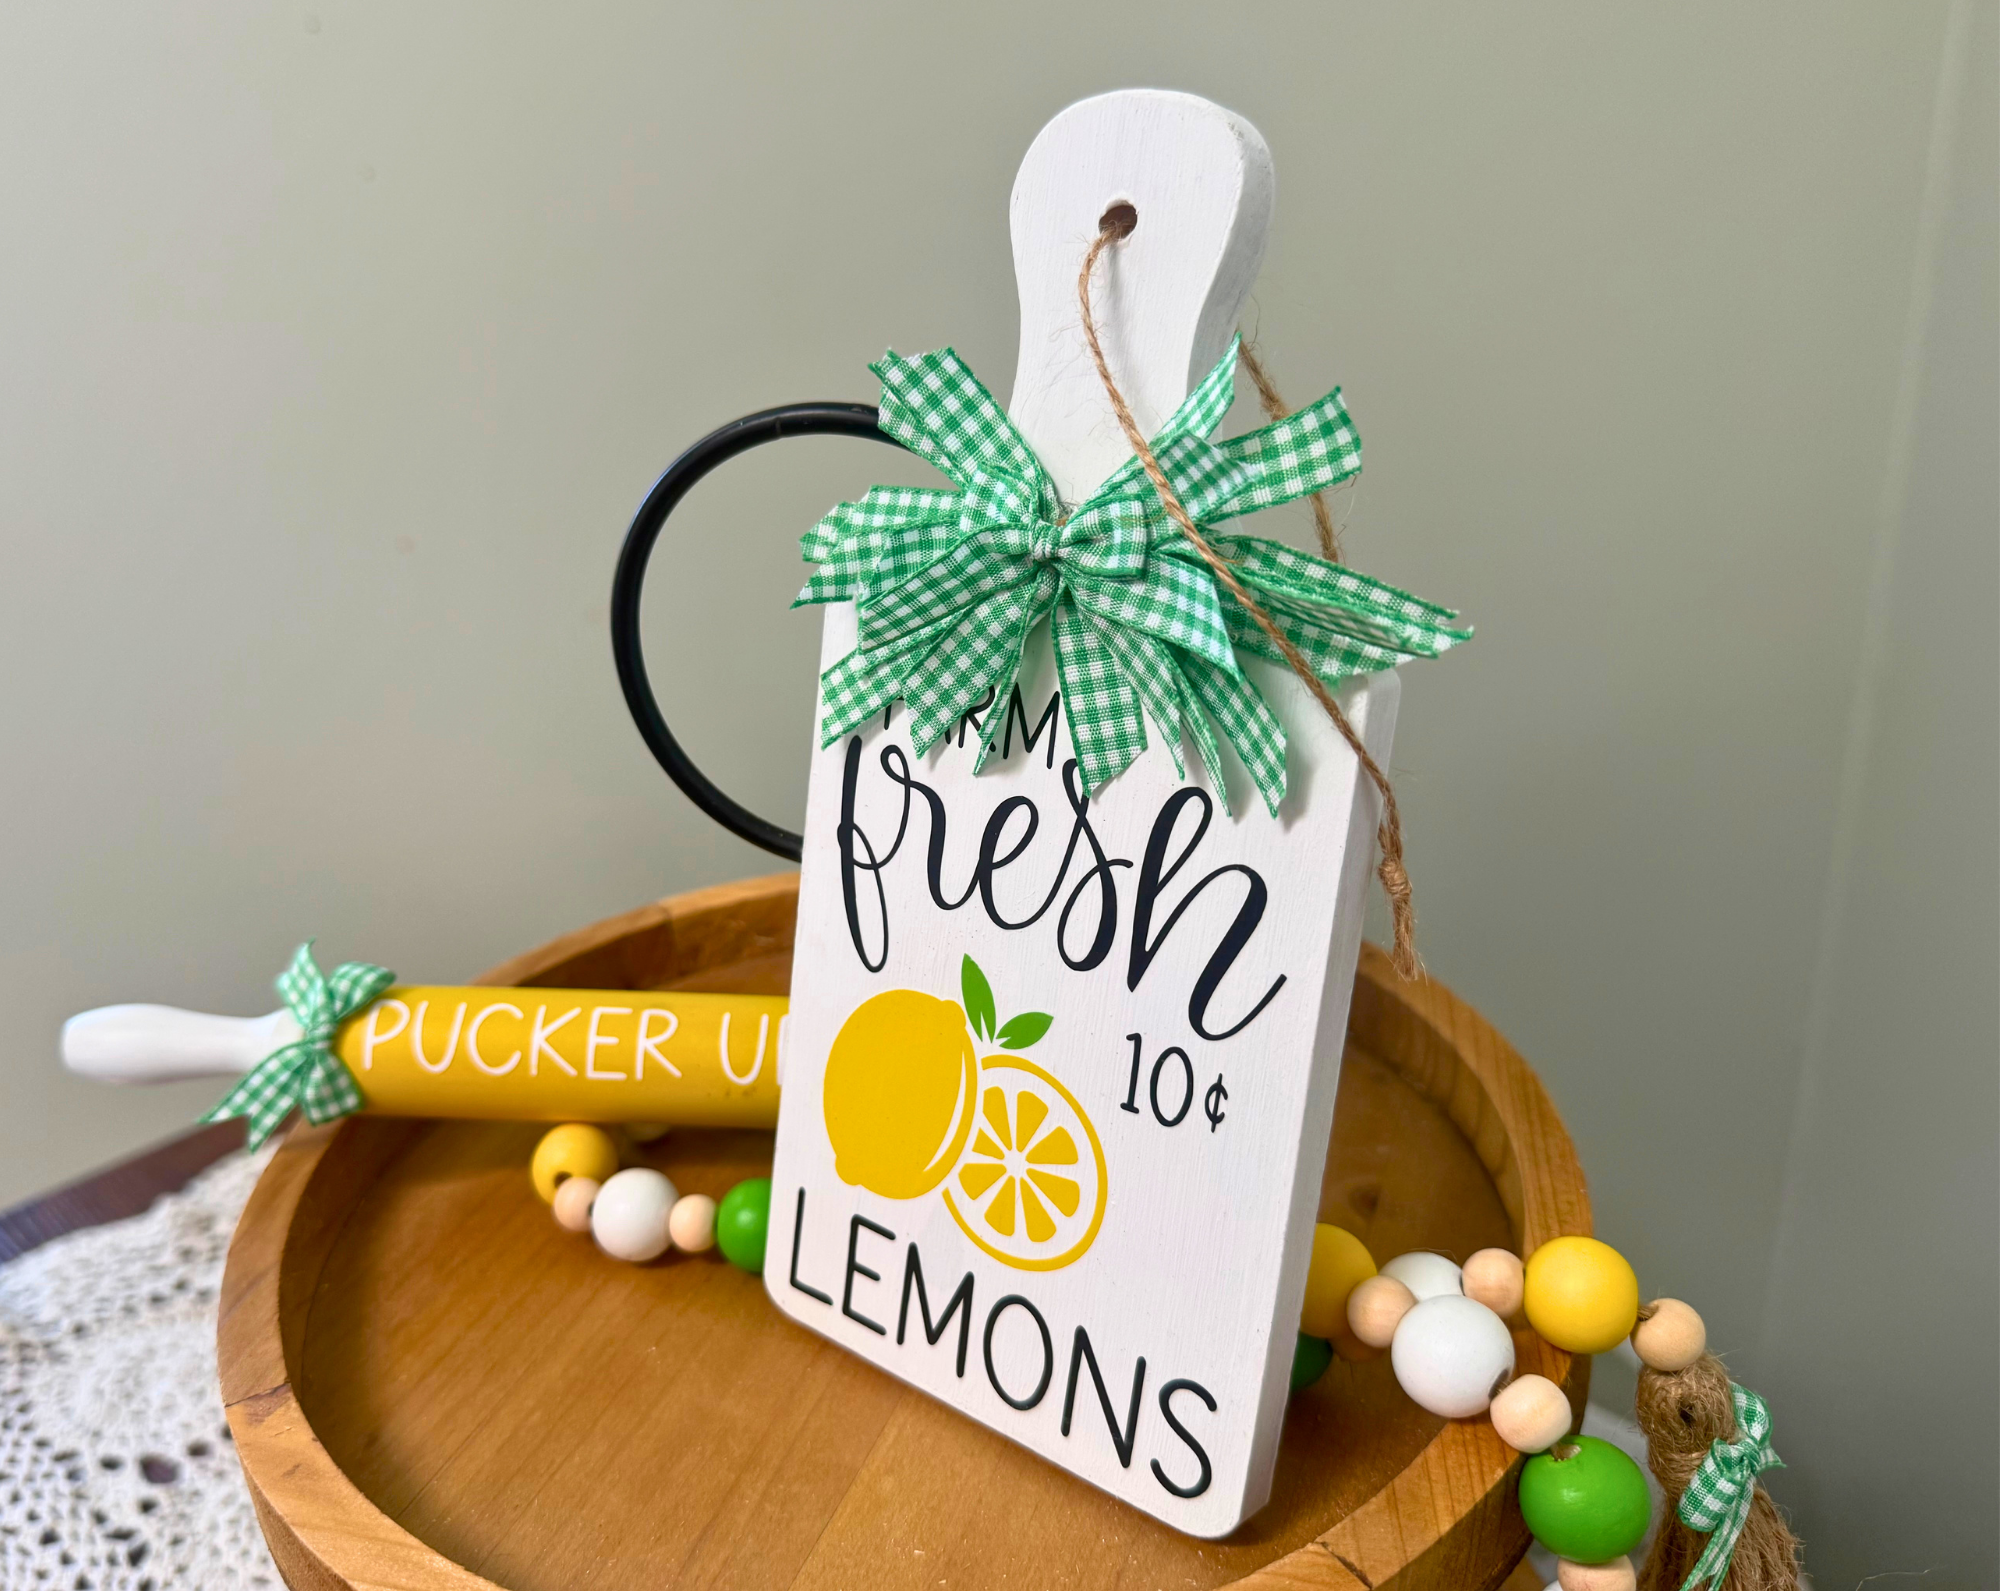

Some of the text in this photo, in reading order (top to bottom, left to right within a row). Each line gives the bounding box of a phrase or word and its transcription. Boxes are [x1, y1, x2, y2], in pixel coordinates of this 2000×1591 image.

[837, 735, 1288, 1041] fresh
[362, 999, 683, 1081] PUCKER
[1120, 1032, 1229, 1134] 10¢
[789, 1186, 1218, 1499] LEMONS
